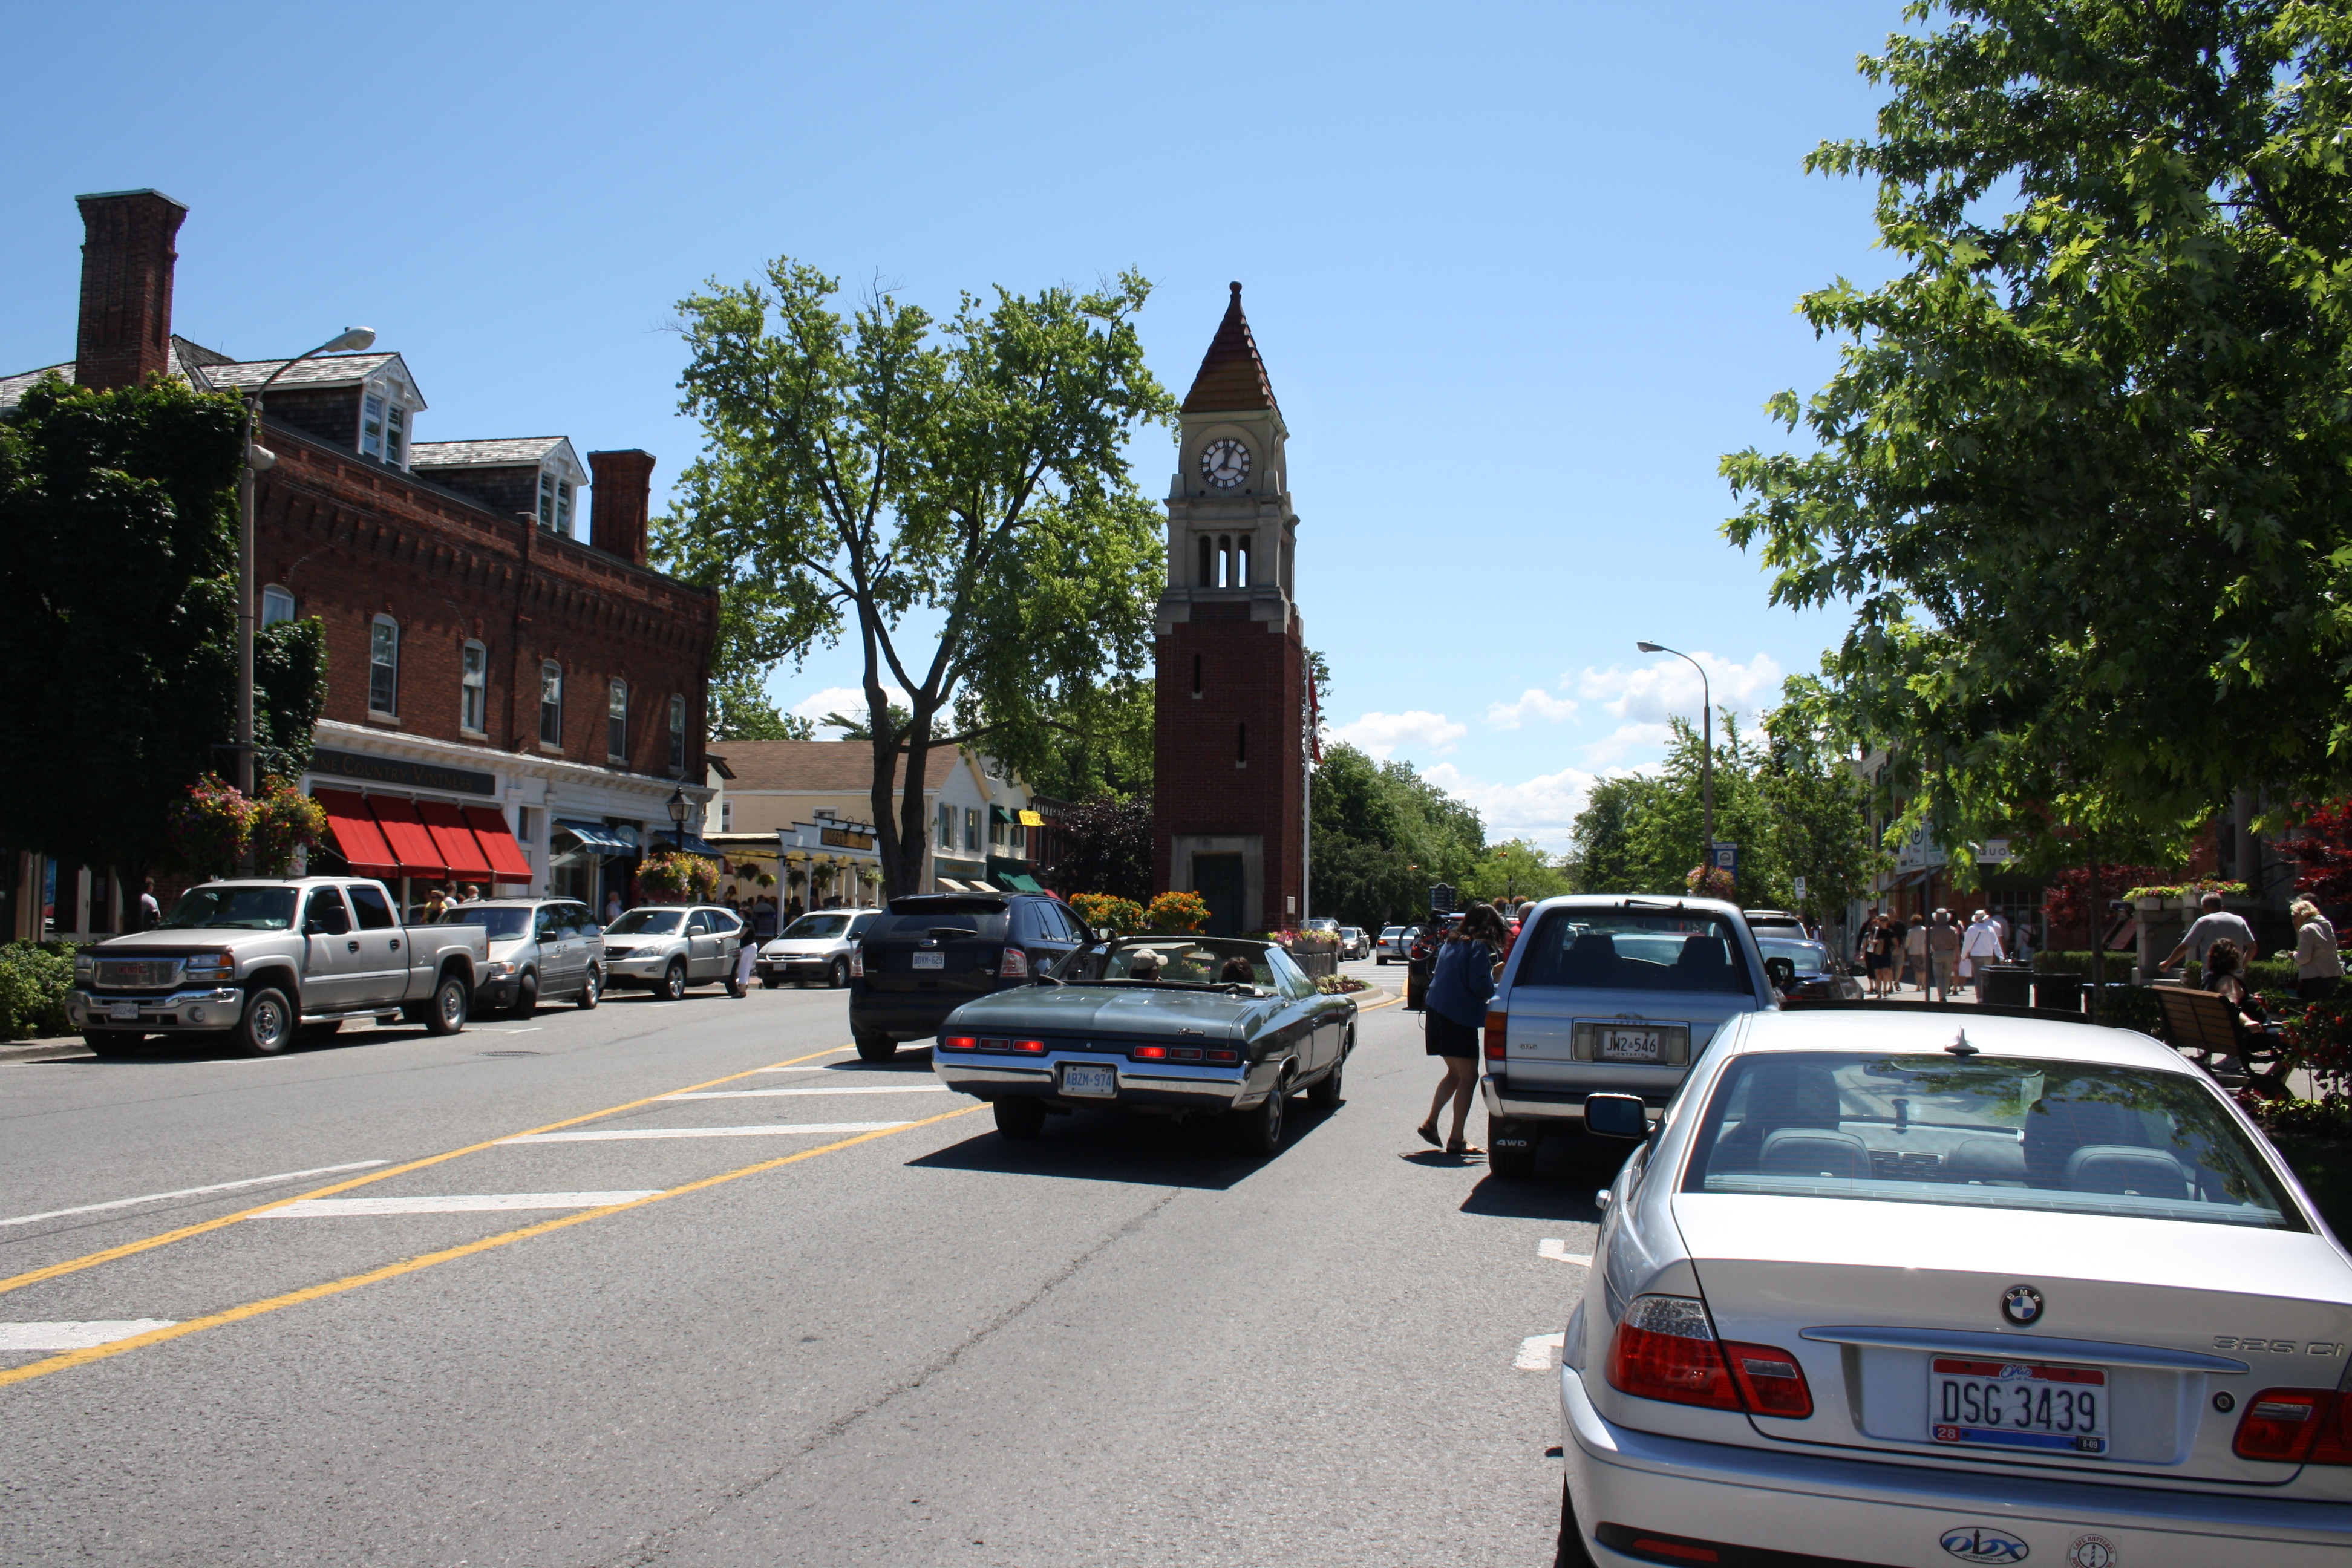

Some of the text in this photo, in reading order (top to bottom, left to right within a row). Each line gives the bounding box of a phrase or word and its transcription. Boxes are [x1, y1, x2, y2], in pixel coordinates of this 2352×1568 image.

[314, 755, 472, 790] INE COUNTRY VINTNERS
[1606, 1037, 1656, 1053] JW2 546
[2006, 1289, 2040, 1302] BMW
[2212, 1335, 2296, 1354] 325
[2000, 1364, 2032, 1379] Ohio
[1942, 1381, 2095, 1433] DSG 3439
[1938, 1428, 1956, 1439] 28
[2073, 1535, 2115, 1555] CAPE HATTERAS
